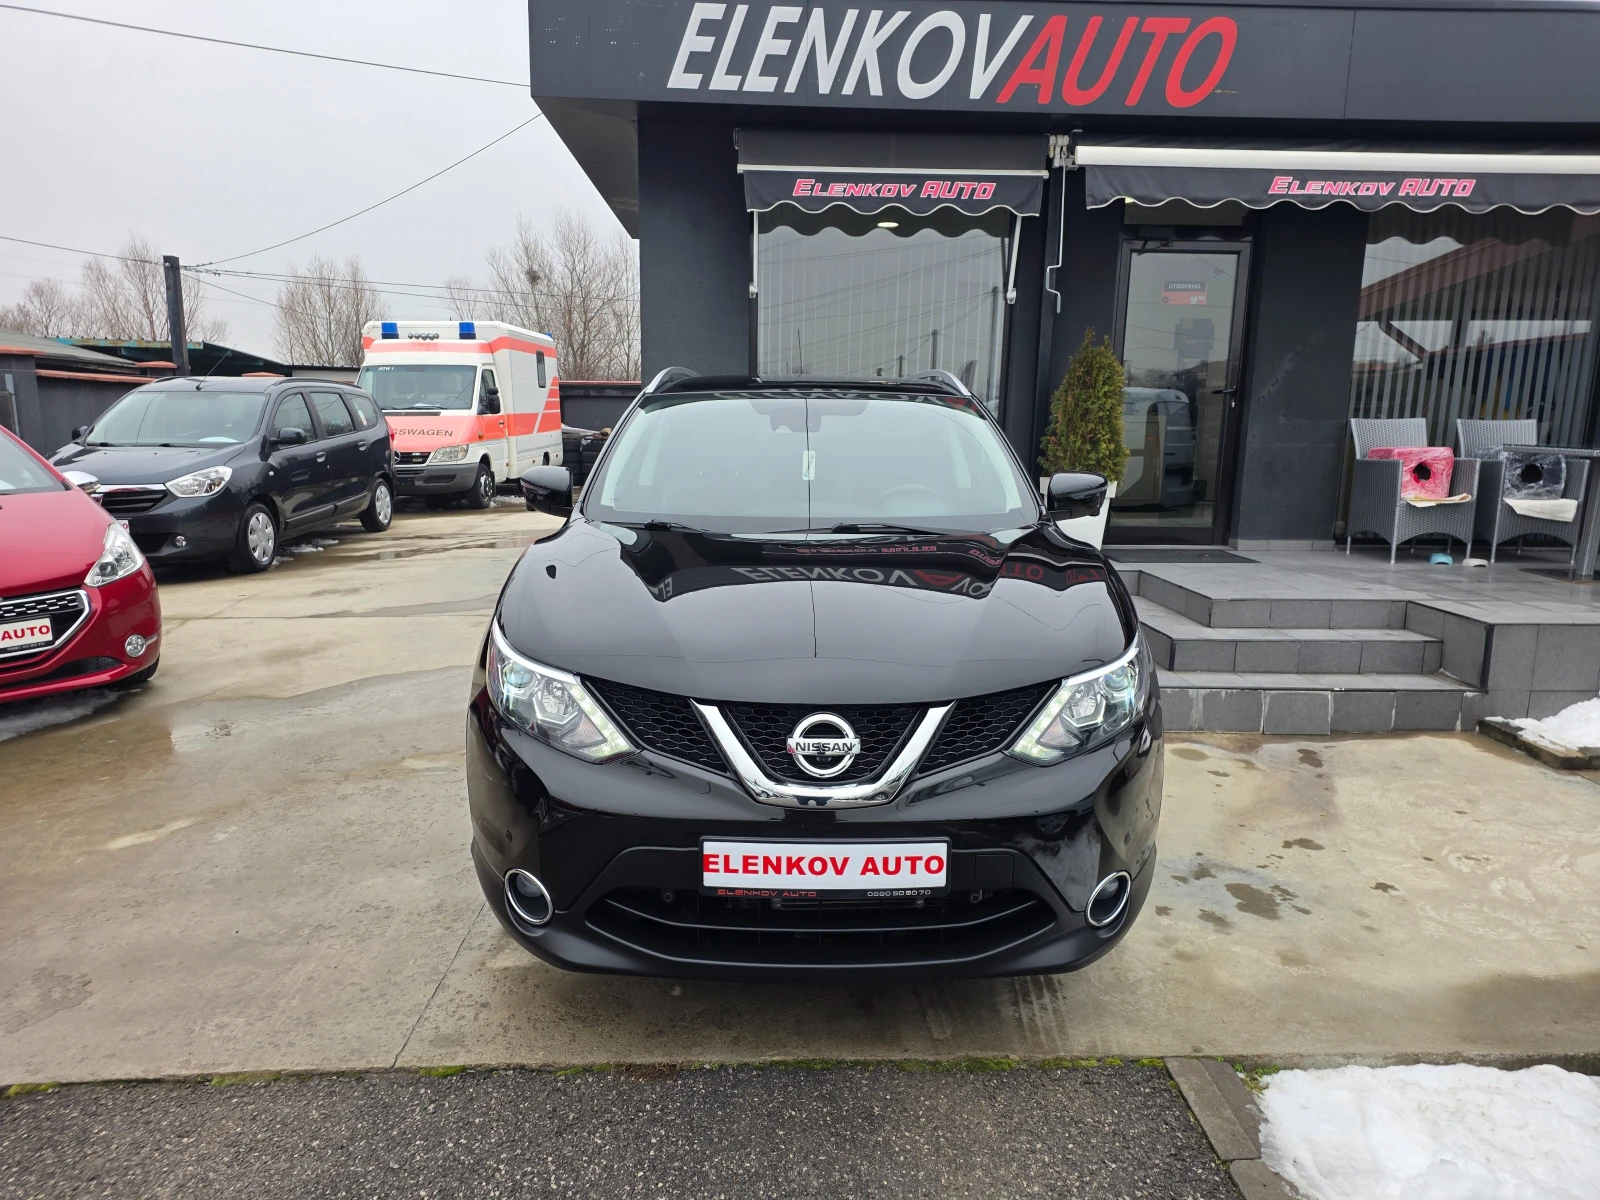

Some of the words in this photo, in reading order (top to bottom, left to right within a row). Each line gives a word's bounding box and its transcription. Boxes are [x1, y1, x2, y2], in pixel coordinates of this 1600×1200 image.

[920, 180, 997, 200] AUTO
[1398, 178, 1477, 198] AUTO
[1, 625, 50, 641] AUTO
[795, 741, 853, 752] NISSAN
[703, 853, 850, 876] ELENKOV
[859, 855, 945, 876] AUTO
[717, 889, 778, 897] ELENKOV
